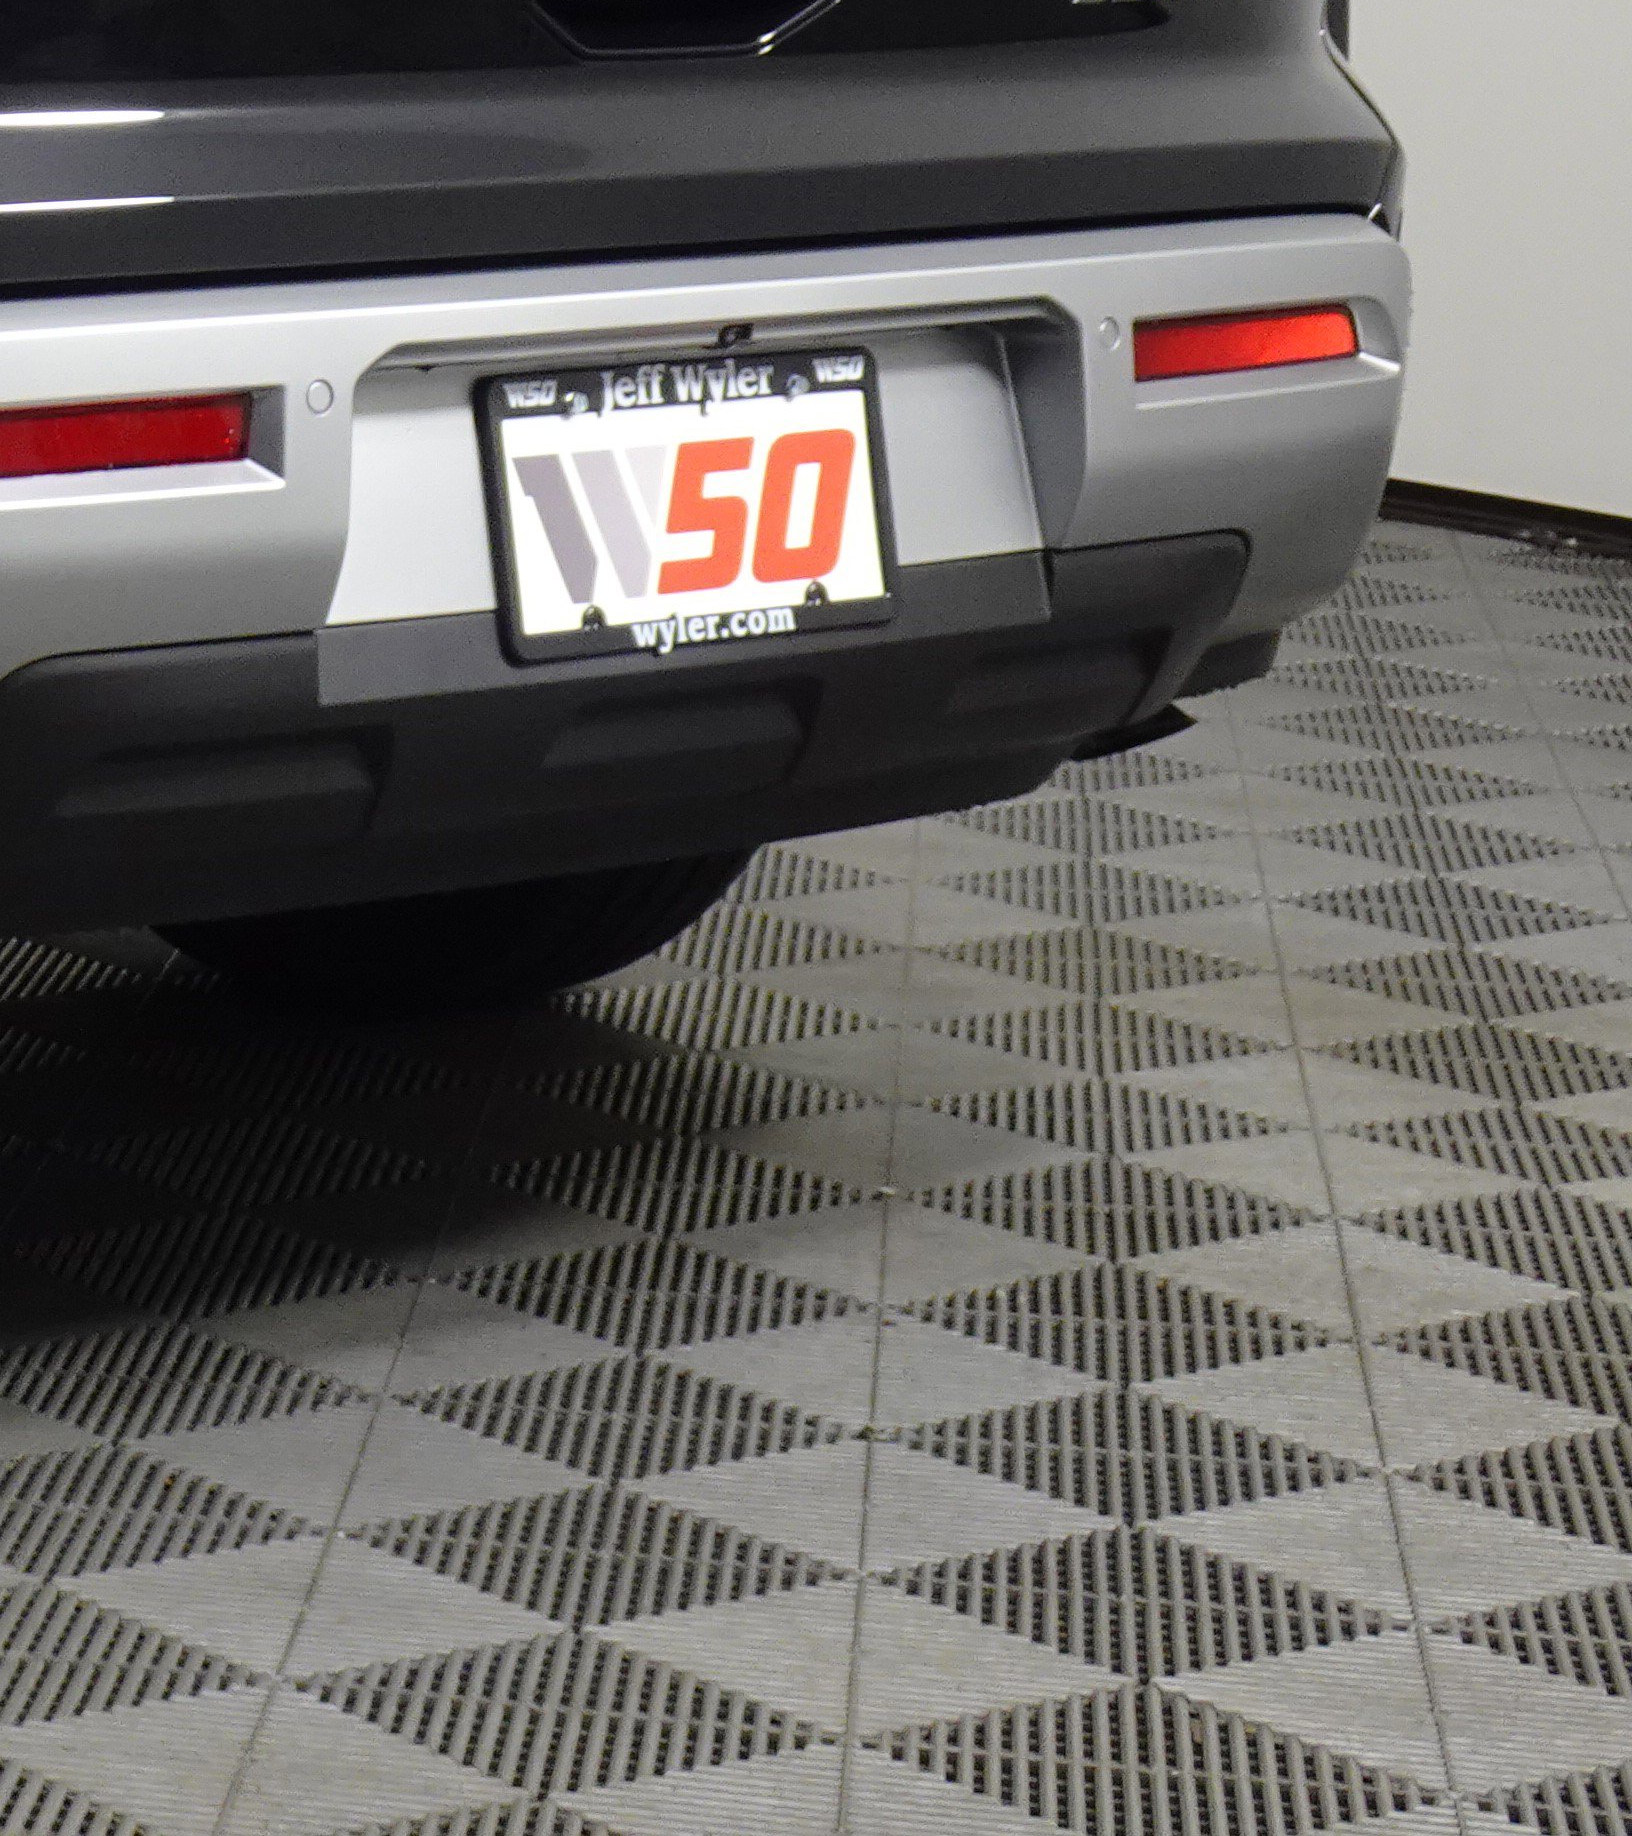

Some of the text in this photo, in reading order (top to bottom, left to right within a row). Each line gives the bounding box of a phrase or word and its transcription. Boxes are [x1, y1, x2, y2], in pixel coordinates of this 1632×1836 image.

[599, 358, 775, 414] Jeff Wyler
[511, 428, 856, 604] W50
[632, 607, 797, 654] wyler.com
